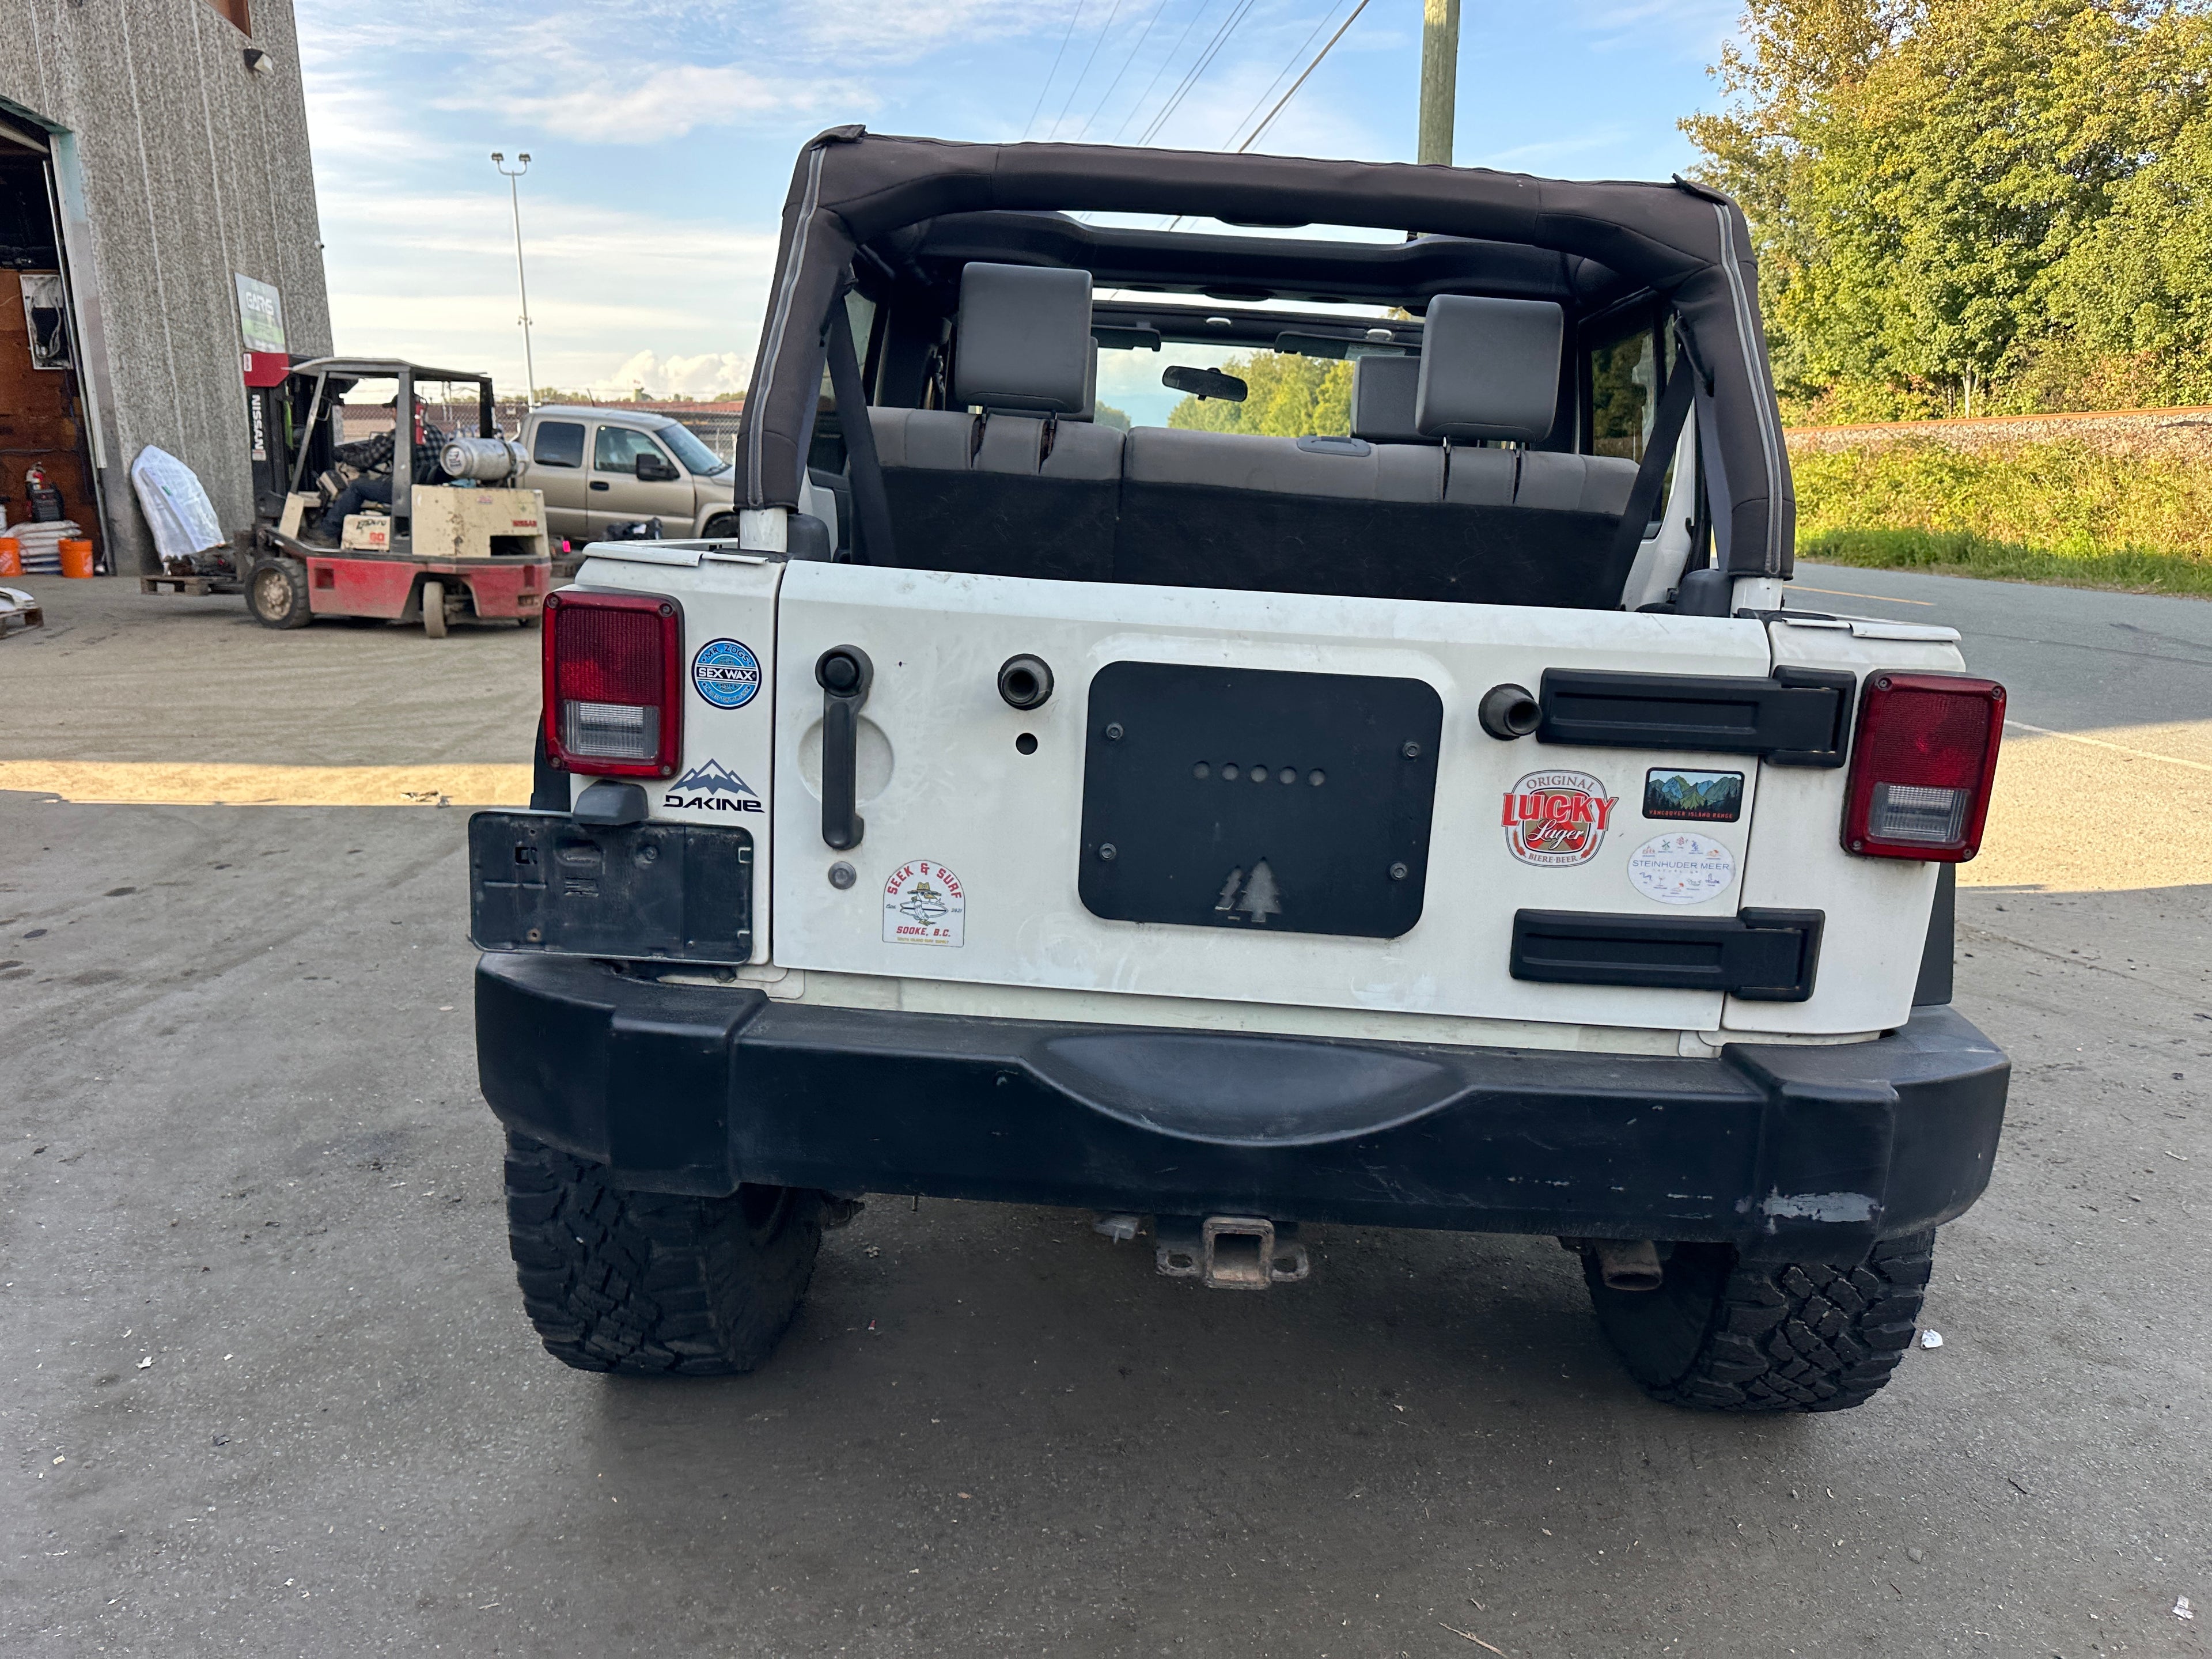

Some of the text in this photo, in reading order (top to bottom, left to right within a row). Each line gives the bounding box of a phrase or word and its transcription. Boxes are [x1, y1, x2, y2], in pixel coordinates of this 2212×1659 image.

[252, 394, 264, 450] NISSAN
[724, 645, 749, 662] ZOGS
[698, 668, 724, 679] SEX
[1527, 775, 1594, 792] ORIGINAL
[1501, 793, 1619, 831] LUCKY
[1527, 819, 1585, 850] Lager
[1633, 860, 1698, 869] STEINHUDER
[887, 866, 914, 895] SEEK
[937, 868, 962, 899] SURF
[896, 926, 950, 937] SOOKE, B.C.
